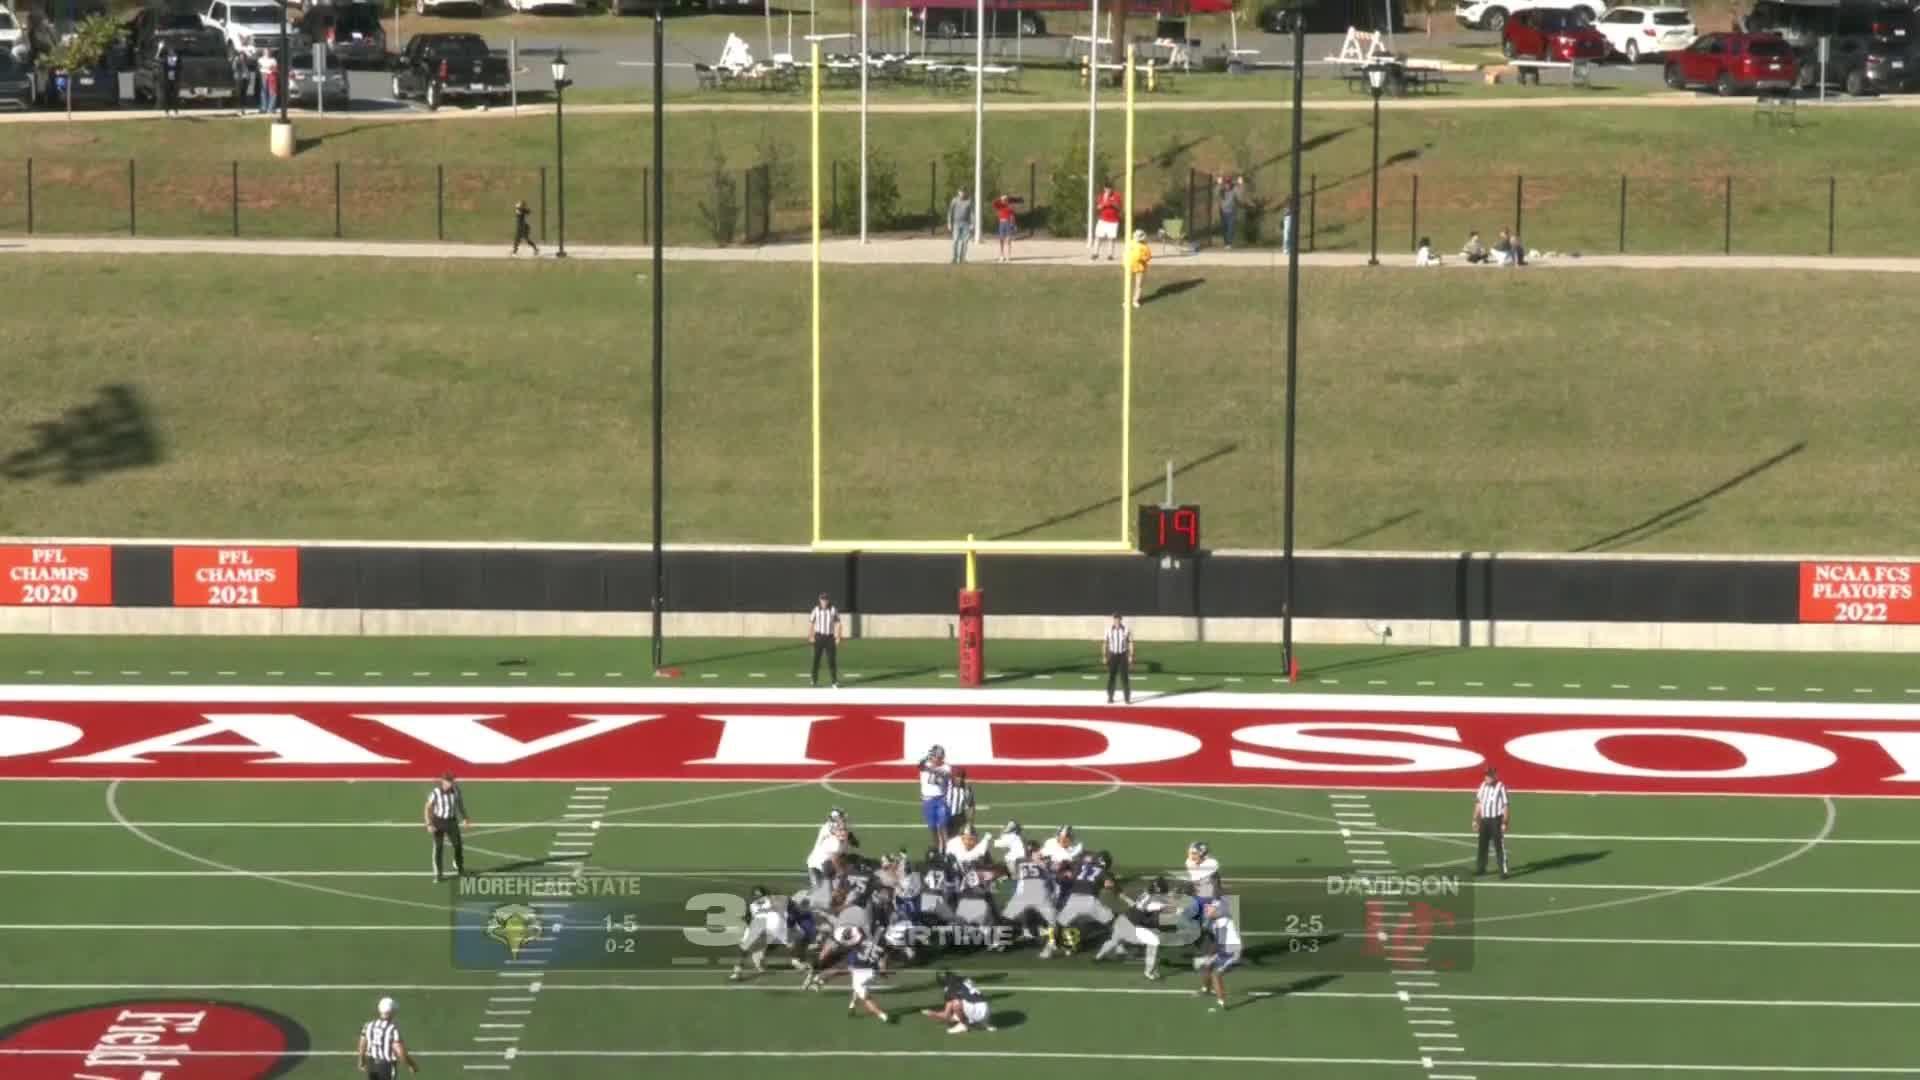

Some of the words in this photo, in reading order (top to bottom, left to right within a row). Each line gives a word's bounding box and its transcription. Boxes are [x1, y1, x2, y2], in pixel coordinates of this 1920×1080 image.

[1158, 510, 1197, 545] 19
[32, 548, 66, 564] PFL
[218, 550, 253, 565] PFL
[10, 567, 89, 581] CHAMPS
[195, 568, 276, 583] CHAMPS
[1815, 565, 1870, 582] NCAA
[1874, 566, 1910, 582] FCS
[21, 585, 78, 603] 2020
[208, 586, 261, 605] 2021
[1812, 583, 1912, 600] PLAYOFFS
[1834, 602, 1888, 622] 2022
[0, 712, 1920, 783] AVIDSO
